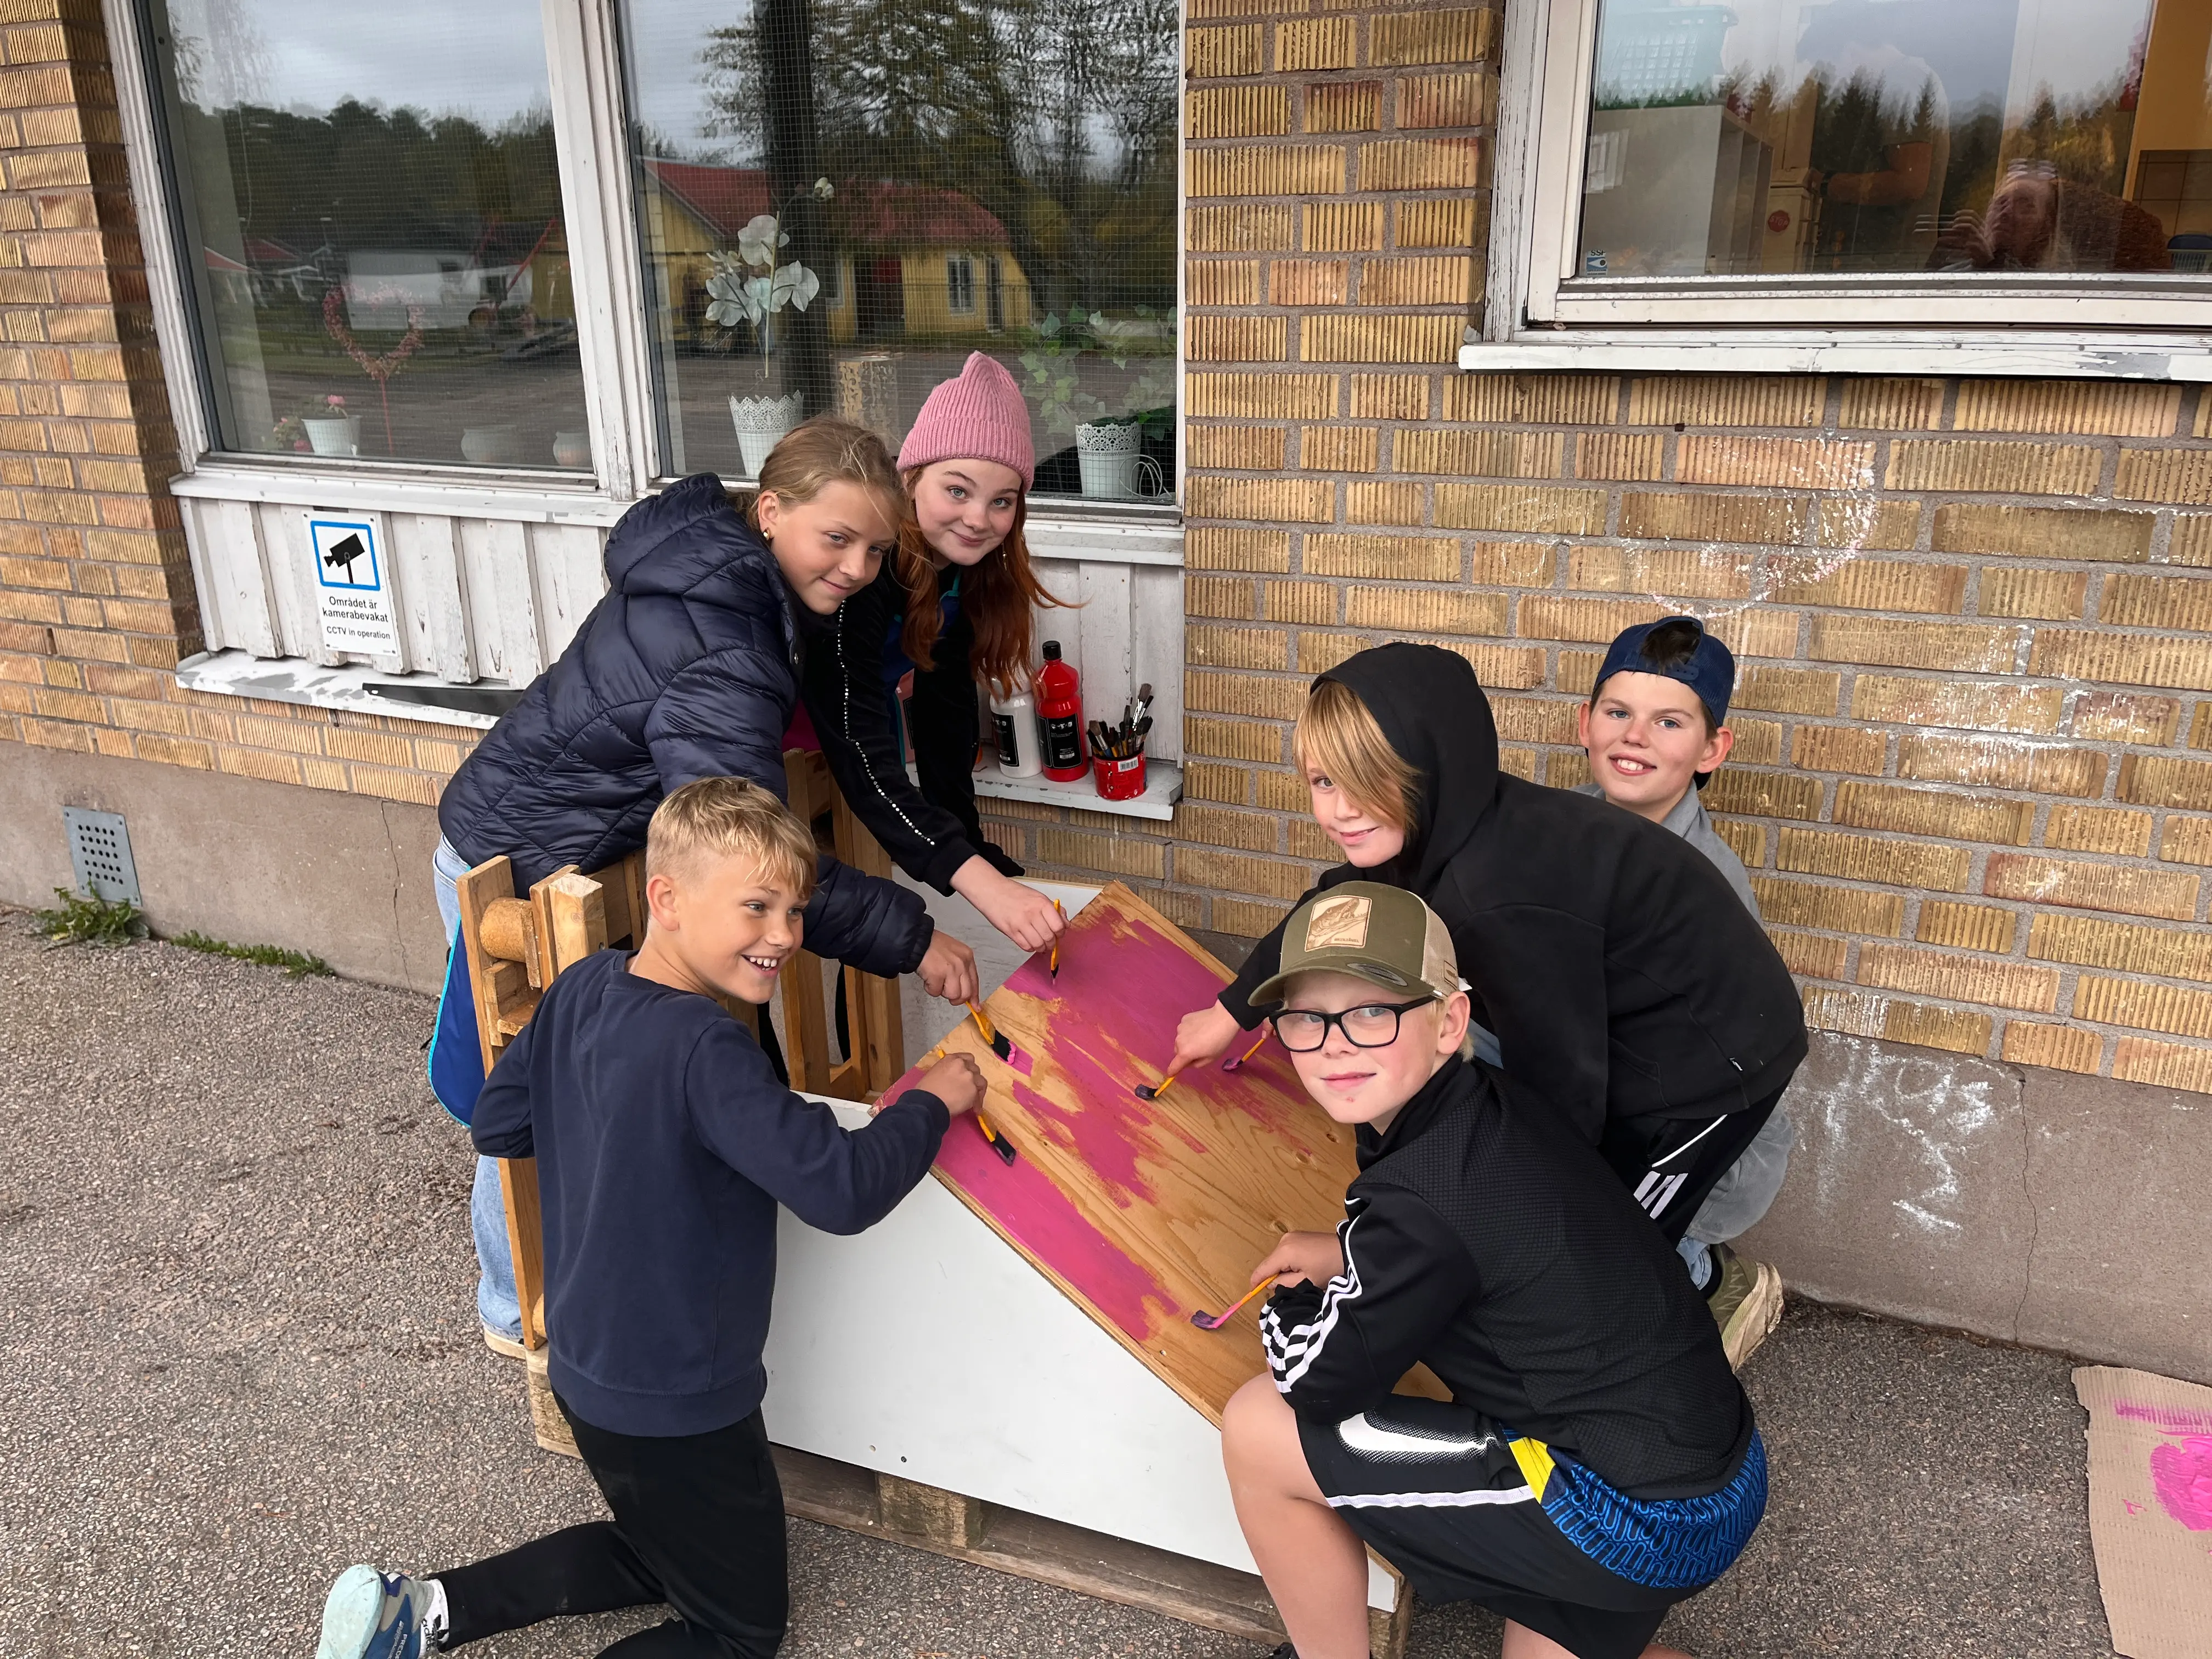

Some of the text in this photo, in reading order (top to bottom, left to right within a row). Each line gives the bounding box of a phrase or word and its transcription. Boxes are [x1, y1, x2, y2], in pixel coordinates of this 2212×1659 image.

[329, 596, 377, 610] Området är
[322, 607, 388, 623] kamerabevakat
[326, 625, 391, 639] CCTV in operation
[421, 1618, 433, 1651] adida
